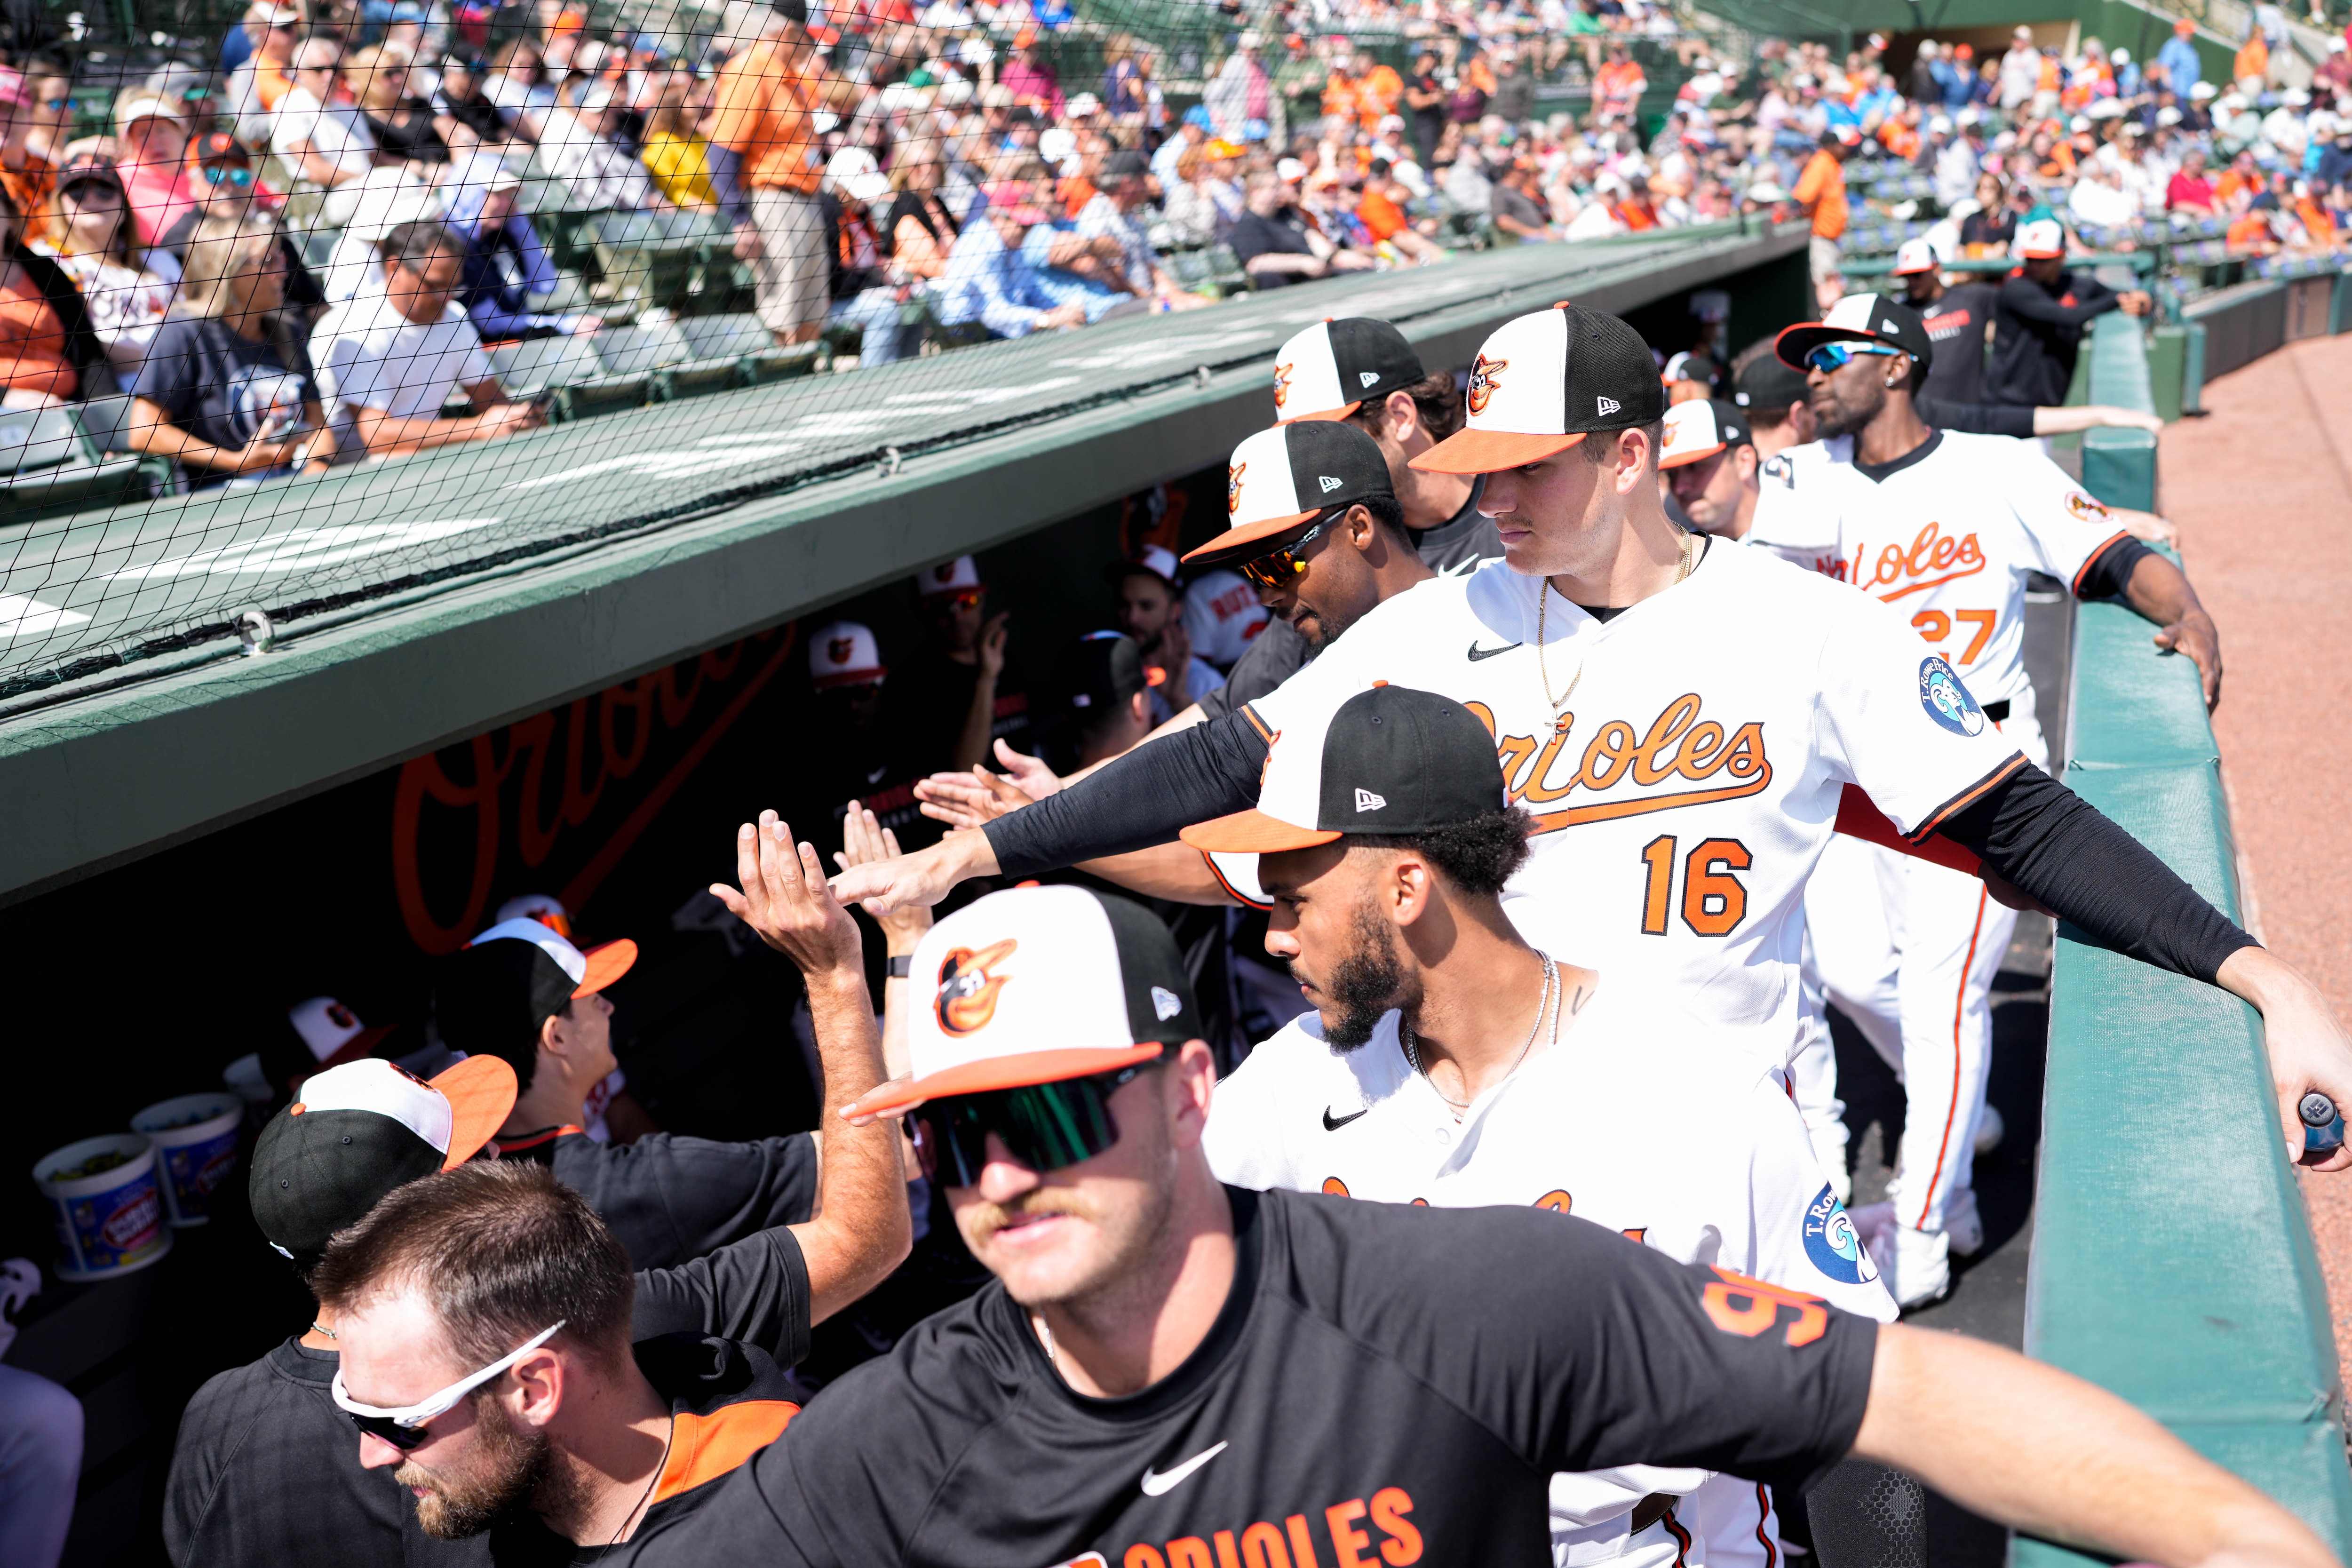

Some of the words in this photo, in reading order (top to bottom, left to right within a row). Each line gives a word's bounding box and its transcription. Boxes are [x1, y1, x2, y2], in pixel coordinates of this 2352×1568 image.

[1819, 521, 1986, 593] ioles
[1911, 610, 1996, 665] 27
[1931, 658, 1954, 682] Price
[1463, 692, 1767, 804] rioles
[392, 628, 781, 956] Orio
[1641, 834, 1753, 937] 16
[1809, 1189, 1837, 1221] Ro
